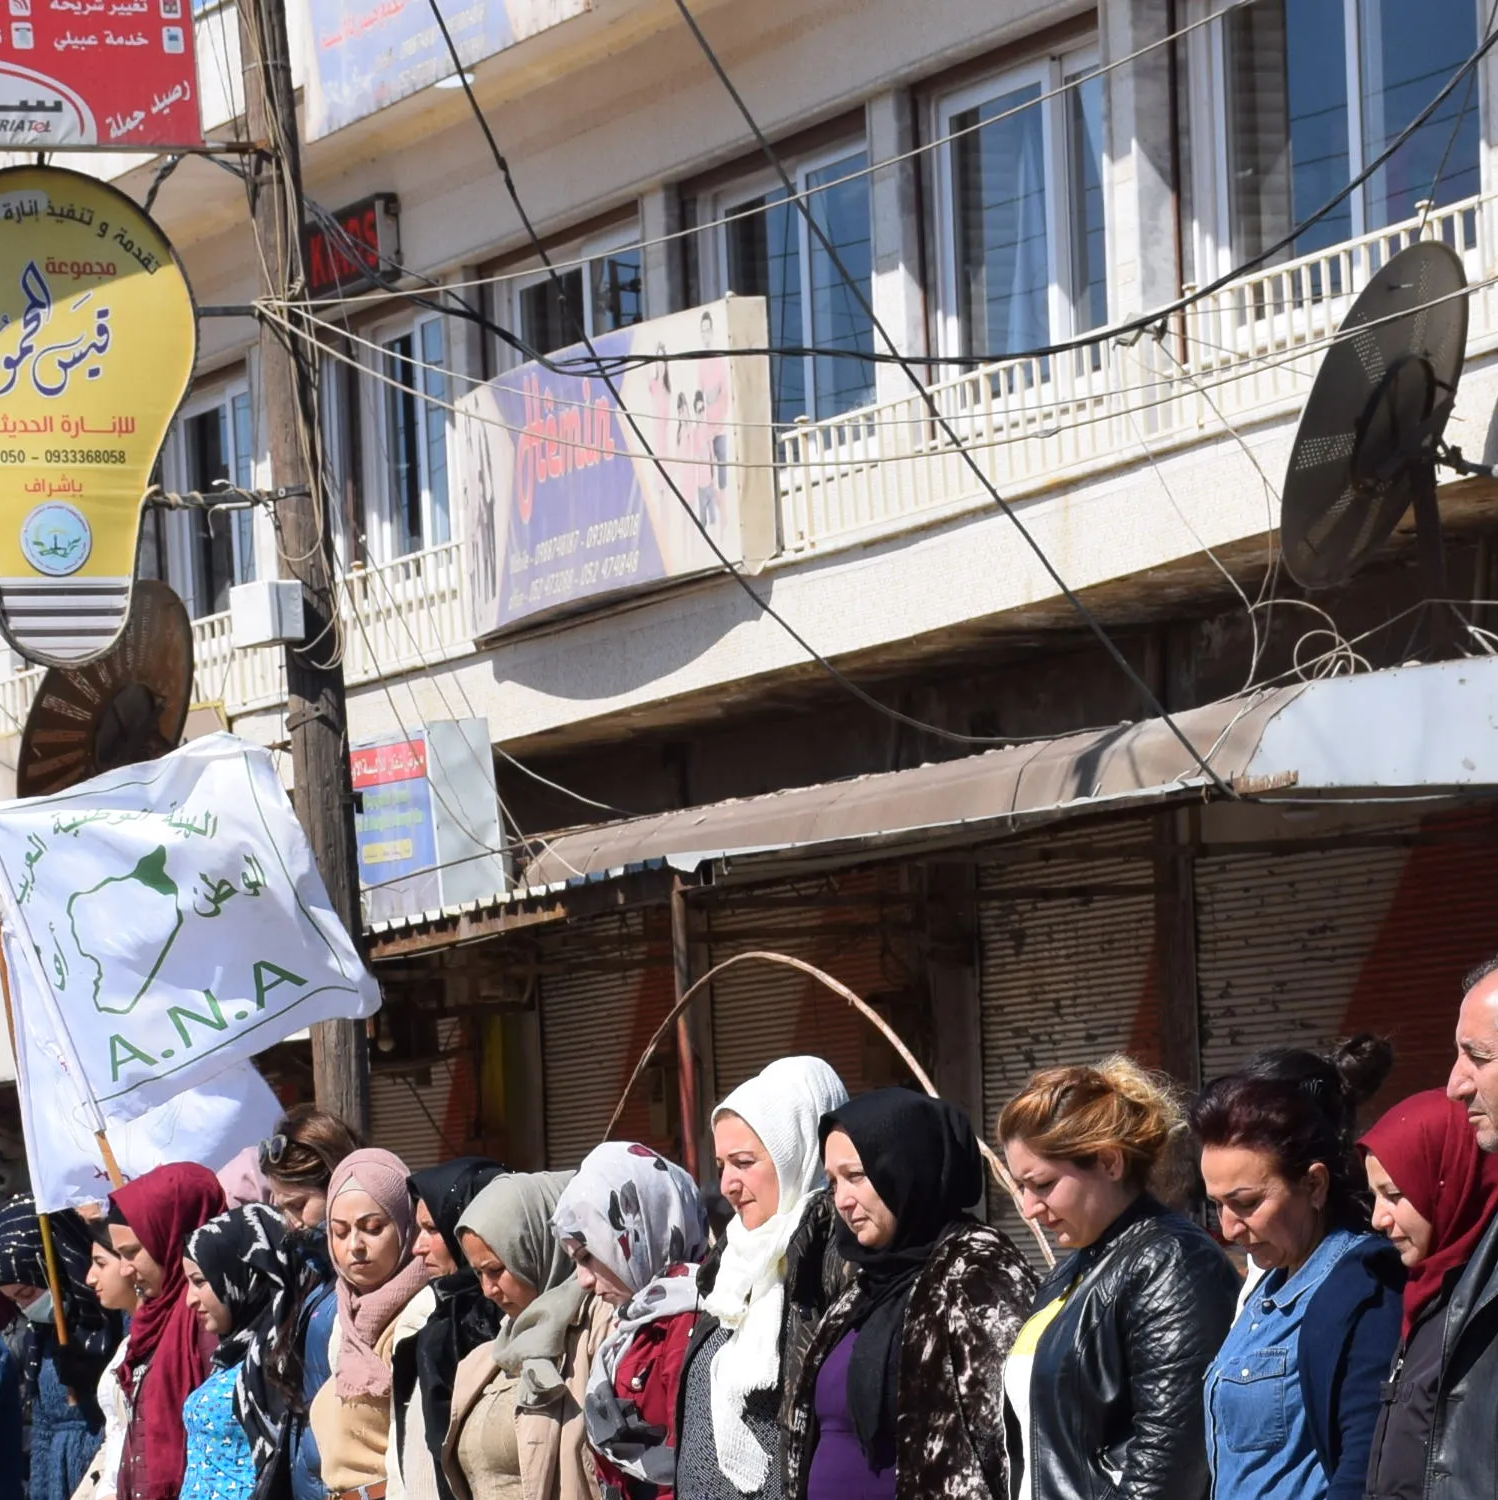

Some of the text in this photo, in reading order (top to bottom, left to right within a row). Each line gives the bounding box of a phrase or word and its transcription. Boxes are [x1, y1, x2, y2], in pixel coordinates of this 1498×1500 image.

[106, 31, 150, 47] خدمة
[105, 79, 191, 139] رصيد جملة
[4, 200, 38, 224] إنارة
[46, 200, 96, 226] تنفيذ
[97, 222, 109, 238] و
[113, 227, 163, 276] تقدمة
[45, 257, 117, 280] مجموعة
[45, 450, 127, 465] 0933368058
[16, 832, 49, 905] العربي
